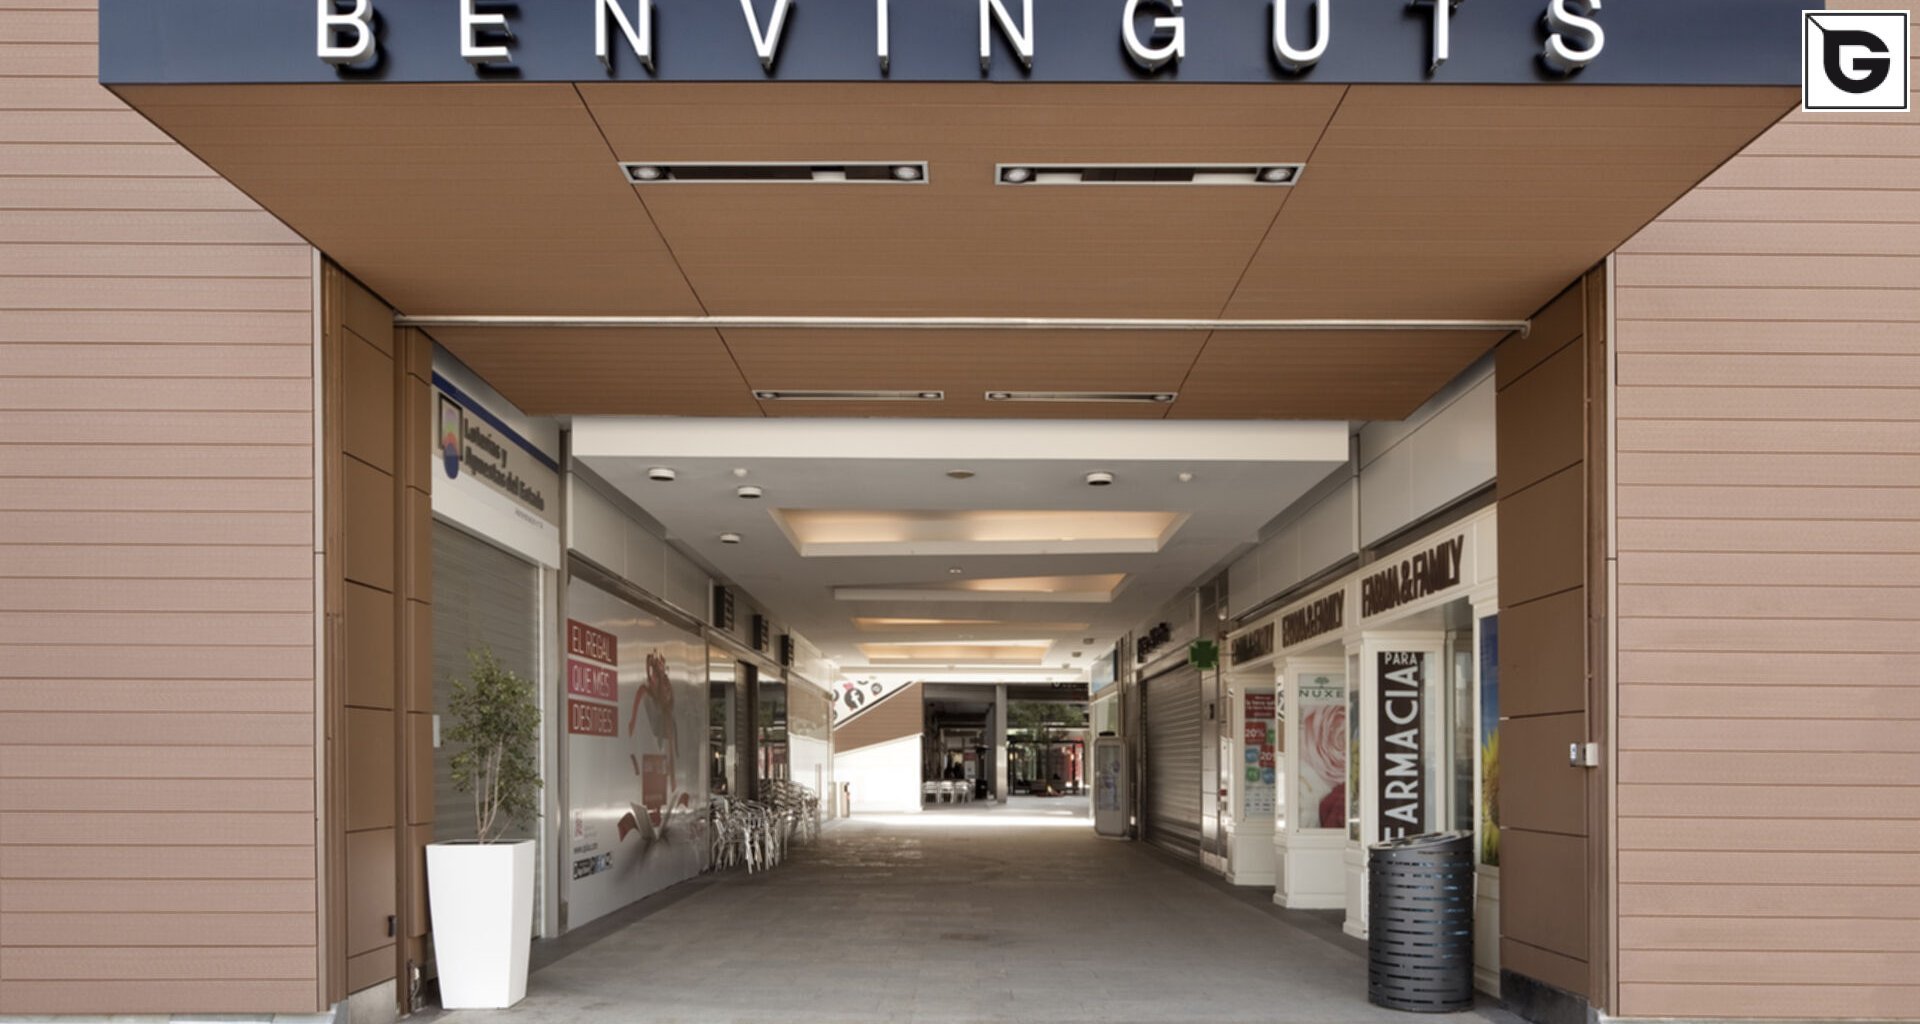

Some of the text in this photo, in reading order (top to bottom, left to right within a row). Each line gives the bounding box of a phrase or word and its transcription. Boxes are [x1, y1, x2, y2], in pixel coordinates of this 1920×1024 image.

[316, 0, 1604, 64] BENVINGUTS
[1361, 534, 1464, 619] FARMA&FAMILY
[571, 625, 613, 663] EL REGAL
[1384, 653, 1418, 666] PARA
[571, 665, 592, 694] QUE
[1298, 689, 1344, 699] NUXE
[1259, 750, 1275, 761] 20
